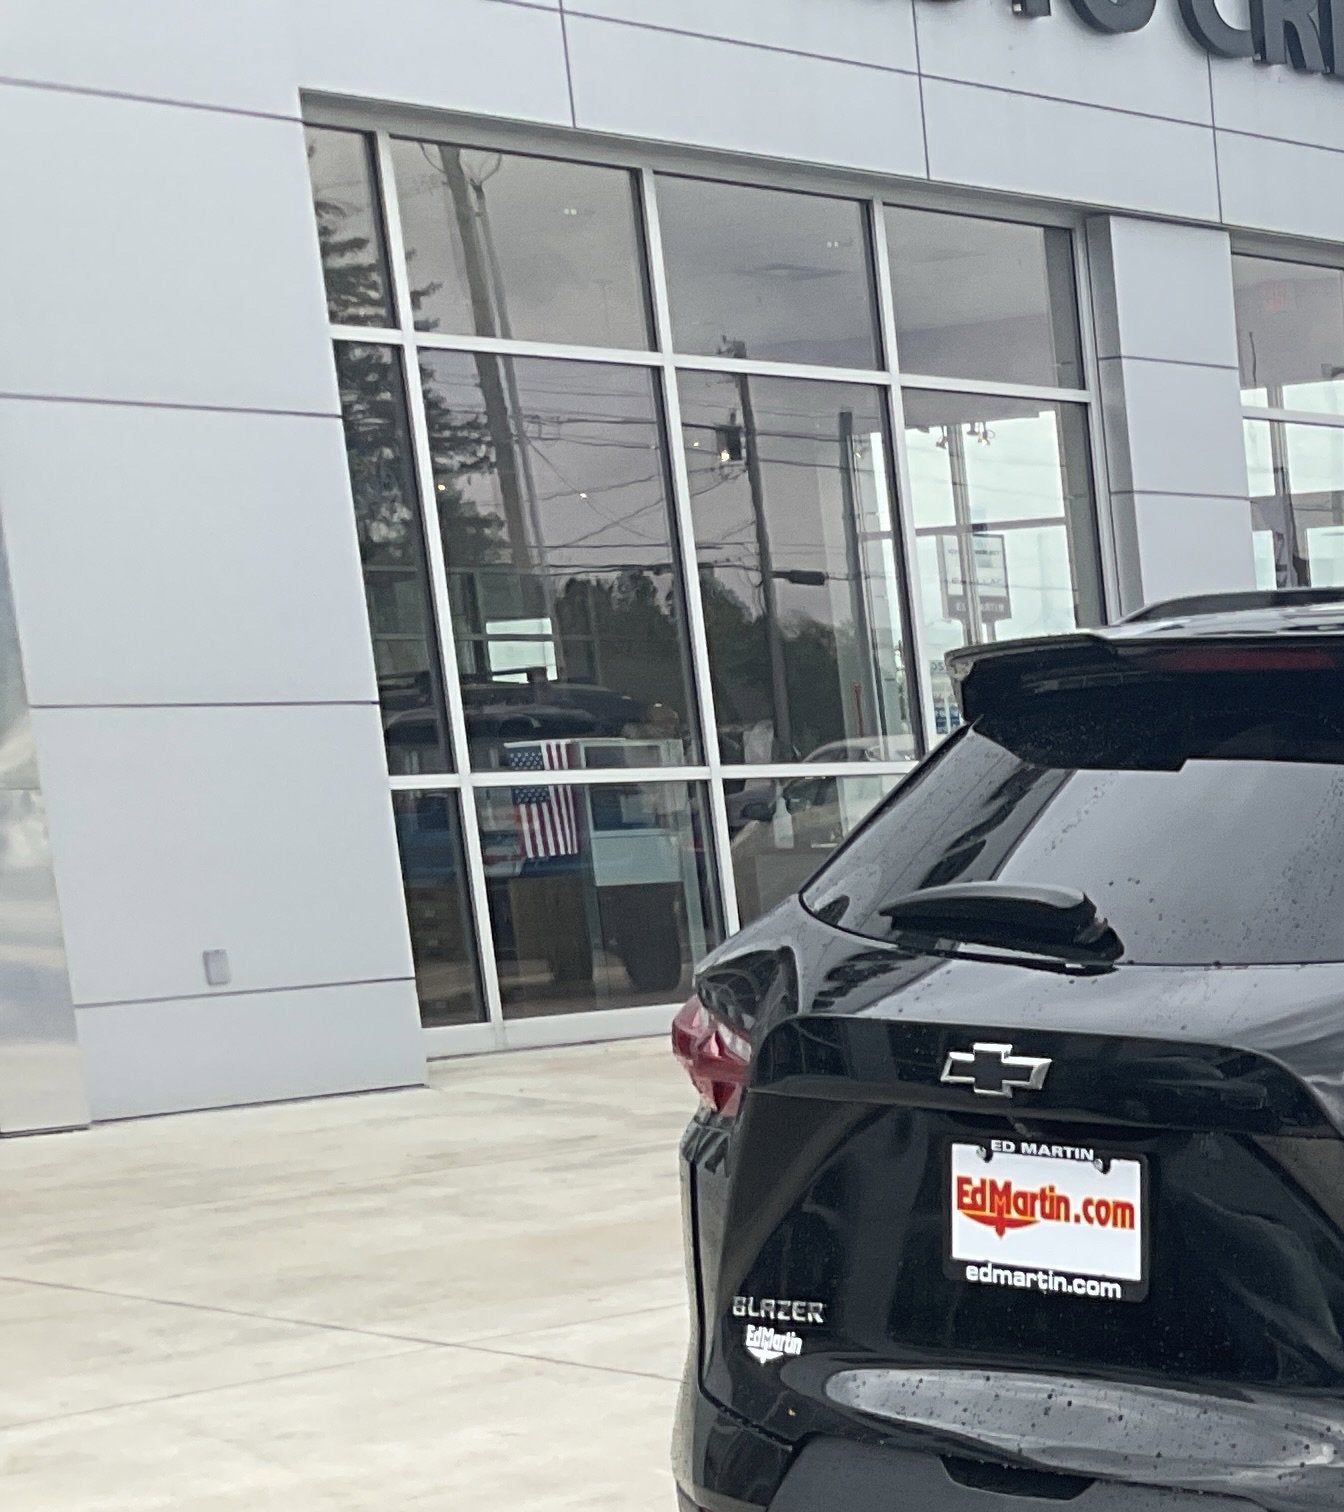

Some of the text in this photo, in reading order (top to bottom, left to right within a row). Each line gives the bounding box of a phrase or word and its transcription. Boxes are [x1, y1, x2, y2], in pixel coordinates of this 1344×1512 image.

[991, 1139, 1095, 1161] ED MARTIN
[956, 1175, 1135, 1230] EdMartin.com
[965, 1261, 1123, 1299] edmartin.com
[732, 1295, 824, 1324] BLAZER
[746, 1324, 803, 1357] EdMartin
